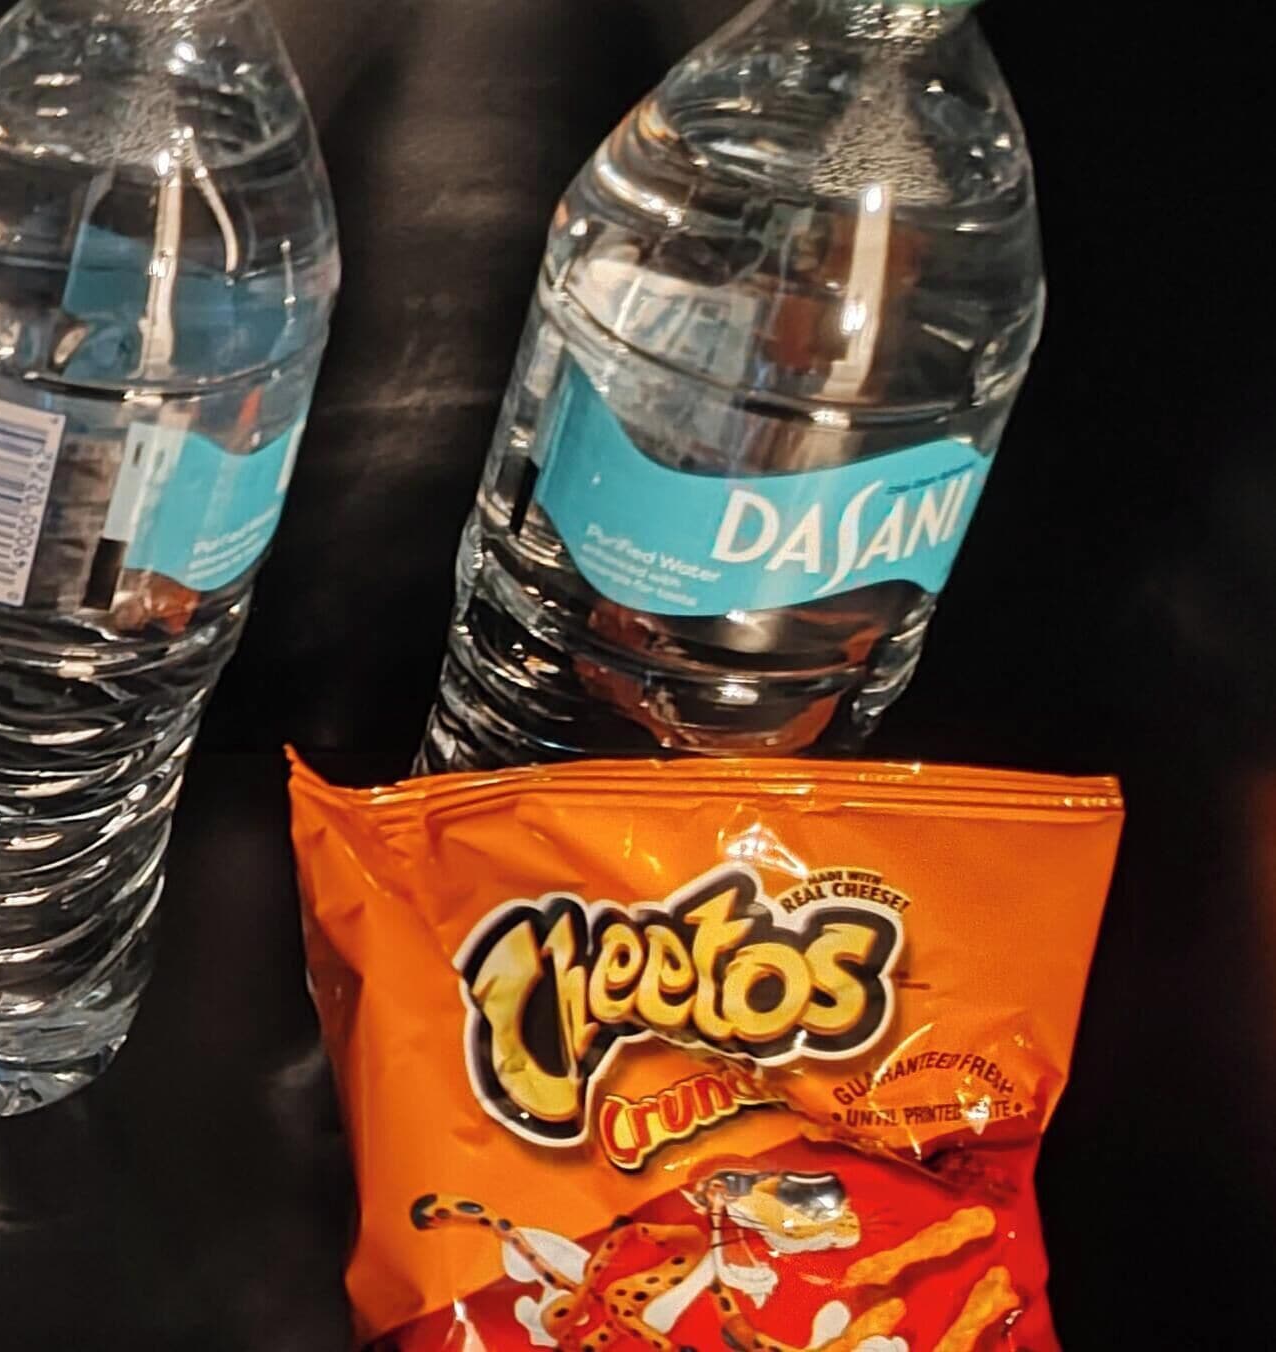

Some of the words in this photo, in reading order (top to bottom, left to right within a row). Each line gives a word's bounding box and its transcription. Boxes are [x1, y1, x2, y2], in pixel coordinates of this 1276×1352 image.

[710, 470, 973, 596] DASANI
[659, 552, 722, 582] Water
[808, 870, 843, 885] MADE
[847, 870, 883, 885] WITH
[780, 884, 828, 914] REAL
[832, 882, 911, 913] CHEESE!
[471, 886, 877, 1122] Cheetos
[904, 1103, 962, 1125] PRINTED
